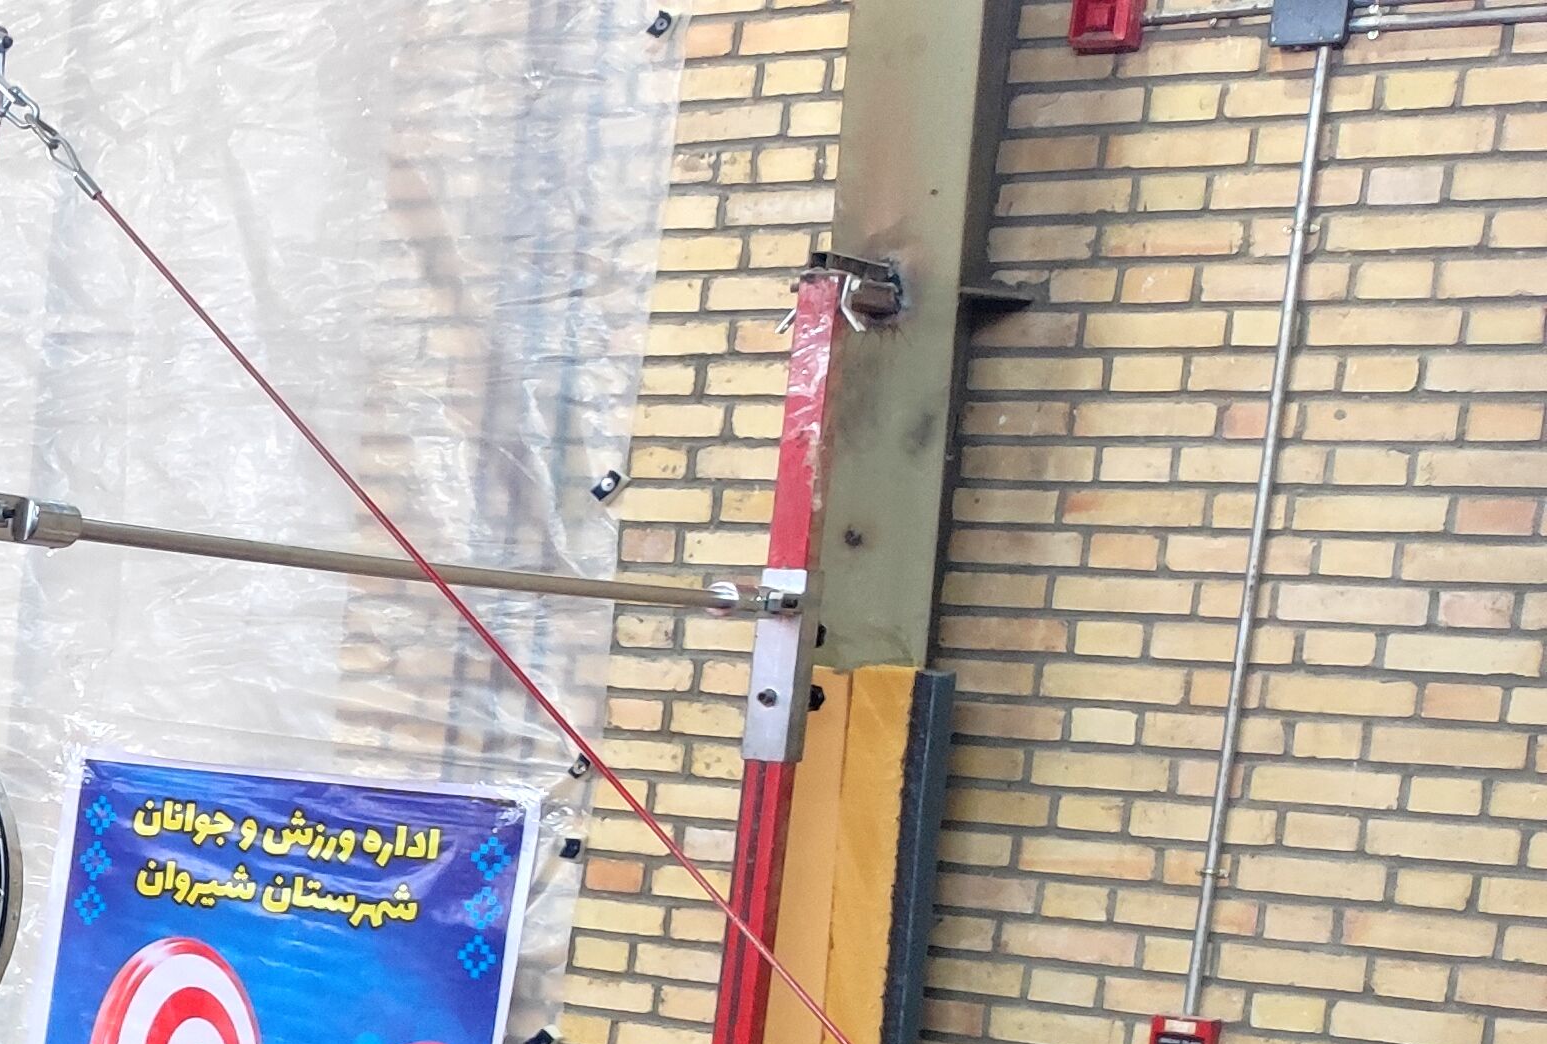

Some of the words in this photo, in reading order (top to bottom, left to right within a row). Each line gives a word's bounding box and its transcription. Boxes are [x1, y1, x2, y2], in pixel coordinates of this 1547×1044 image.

[132, 800, 235, 846] جوانان
[240, 817, 258, 851] و
[262, 809, 356, 863] ورزش
[362, 825, 441, 867] اداره
[136, 858, 257, 906] شیروان
[261, 874, 419, 928] شهرستان
